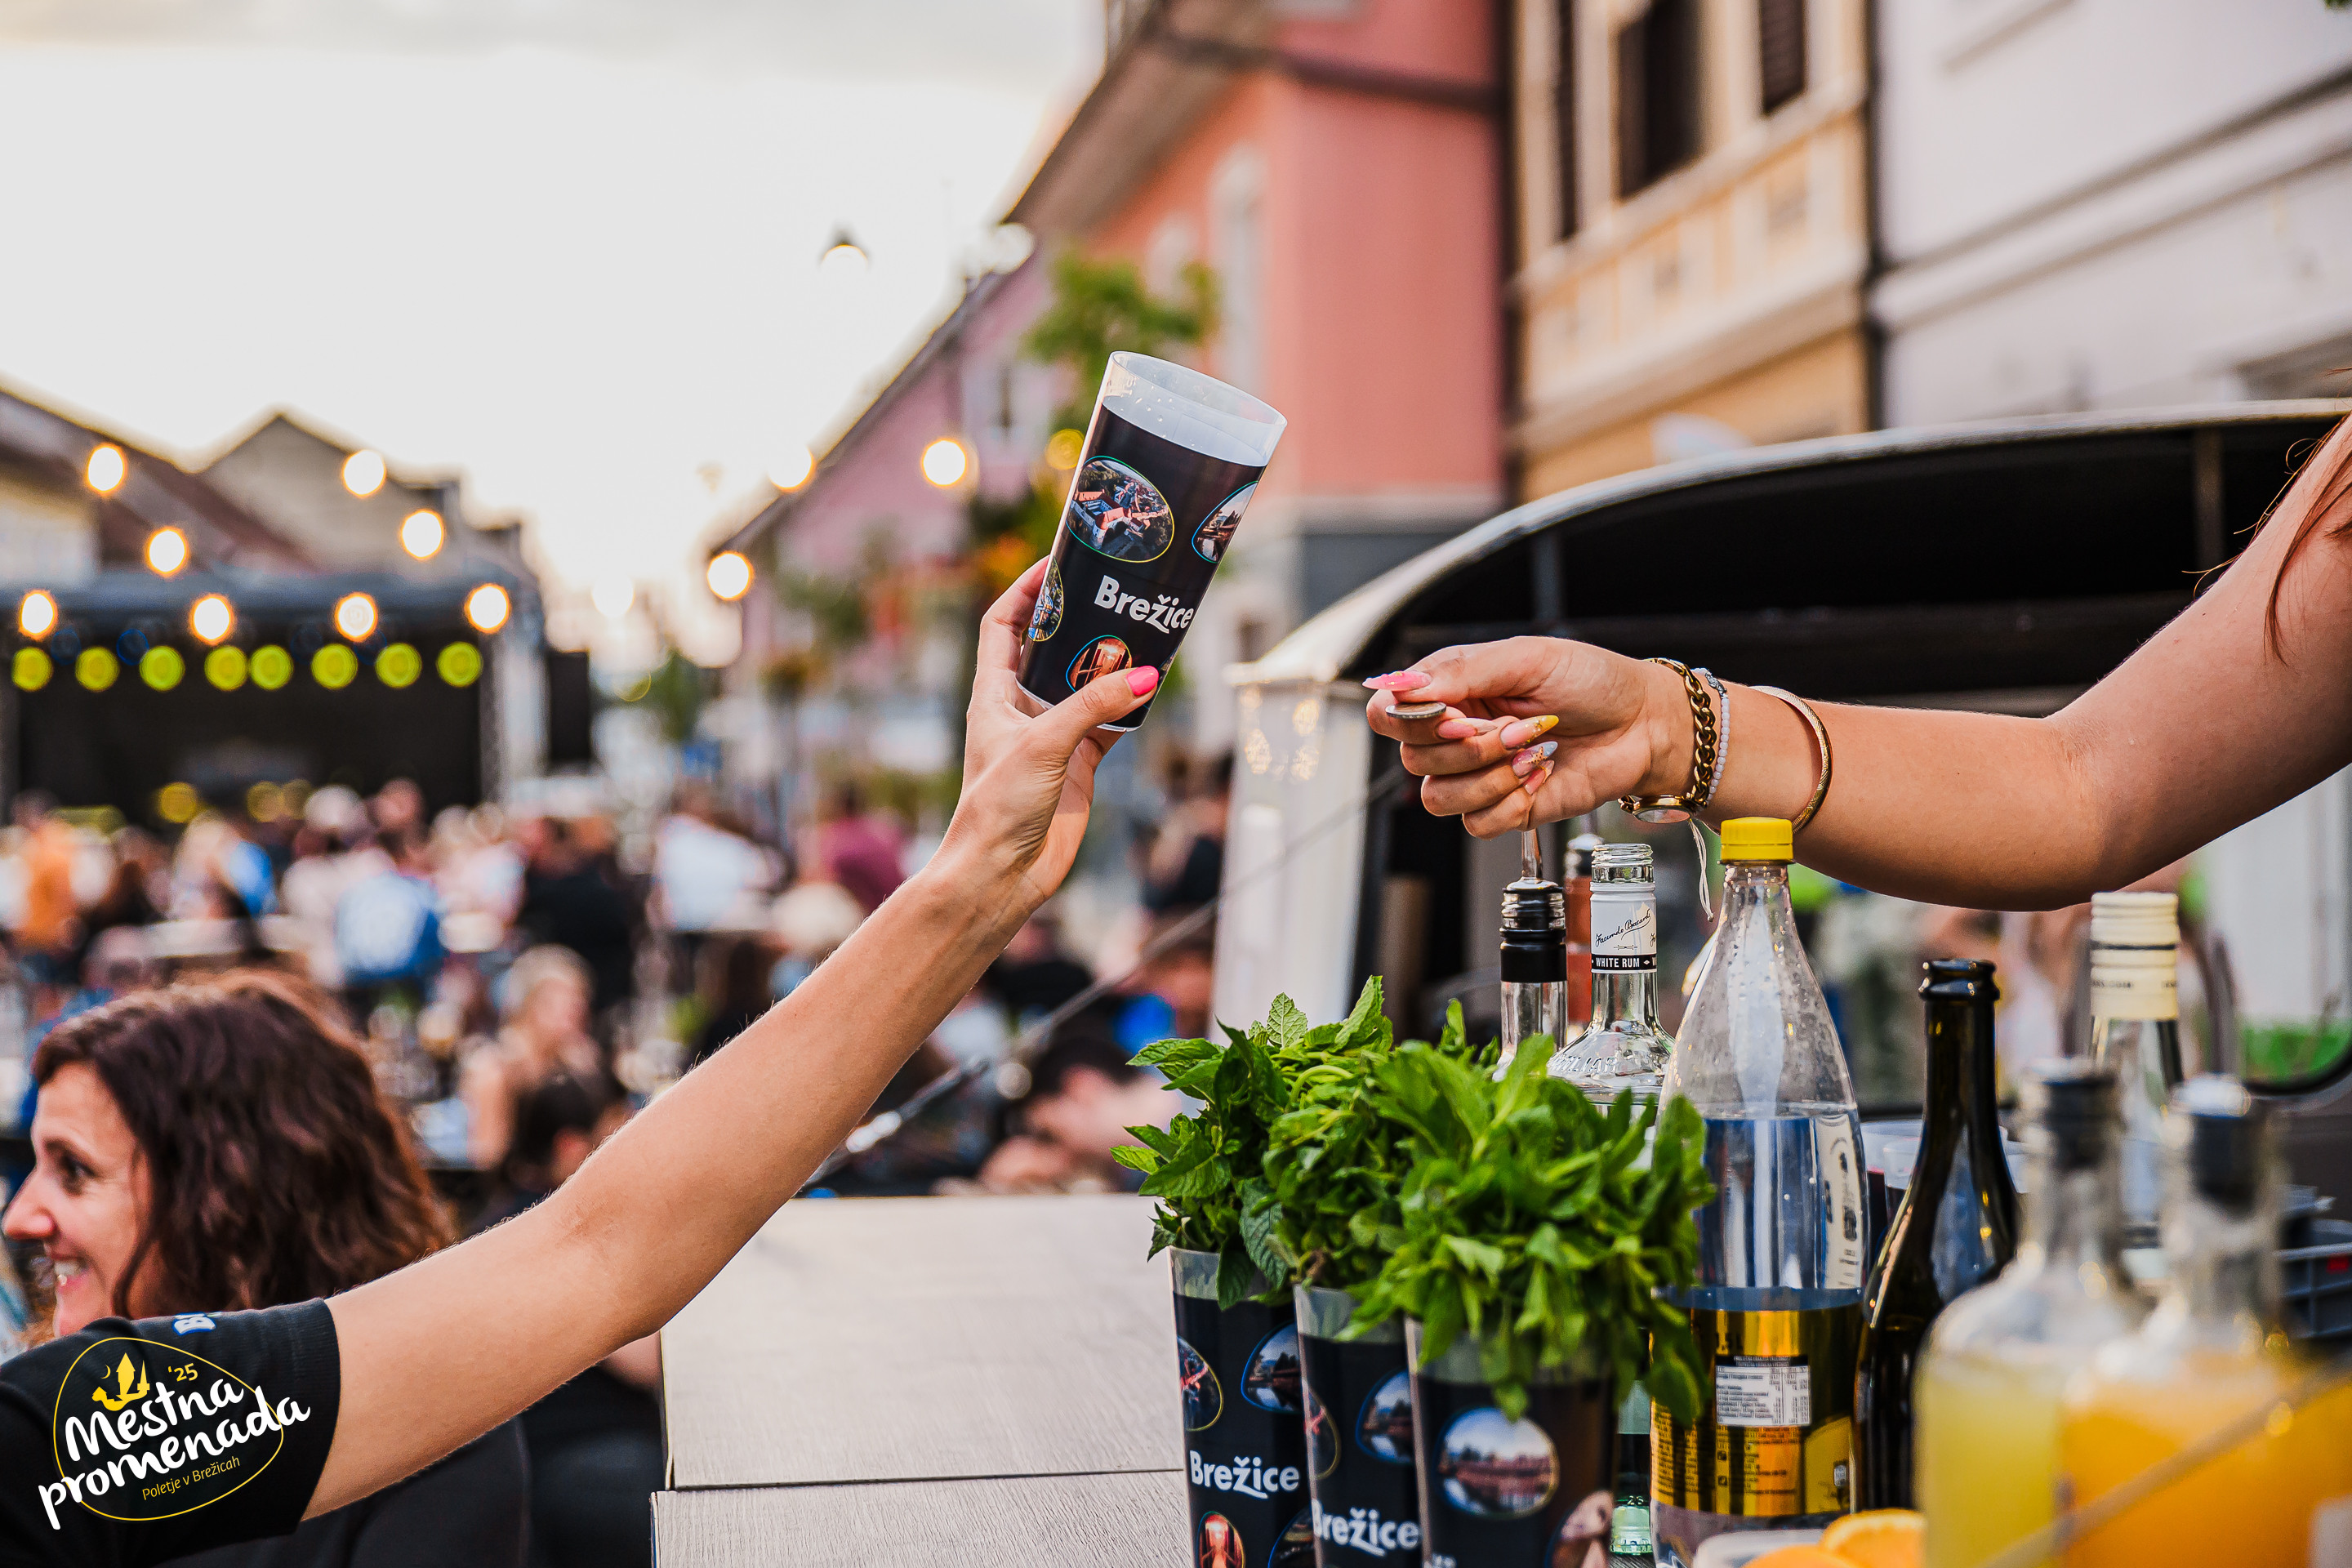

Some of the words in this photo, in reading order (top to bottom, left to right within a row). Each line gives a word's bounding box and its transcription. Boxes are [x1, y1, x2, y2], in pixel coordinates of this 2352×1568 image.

[1094, 575, 1194, 634] Brežice
[1595, 957, 1619, 968] WHITE
[1622, 957, 1640, 968] RUM
[1189, 1450, 1300, 1499] Brežice
